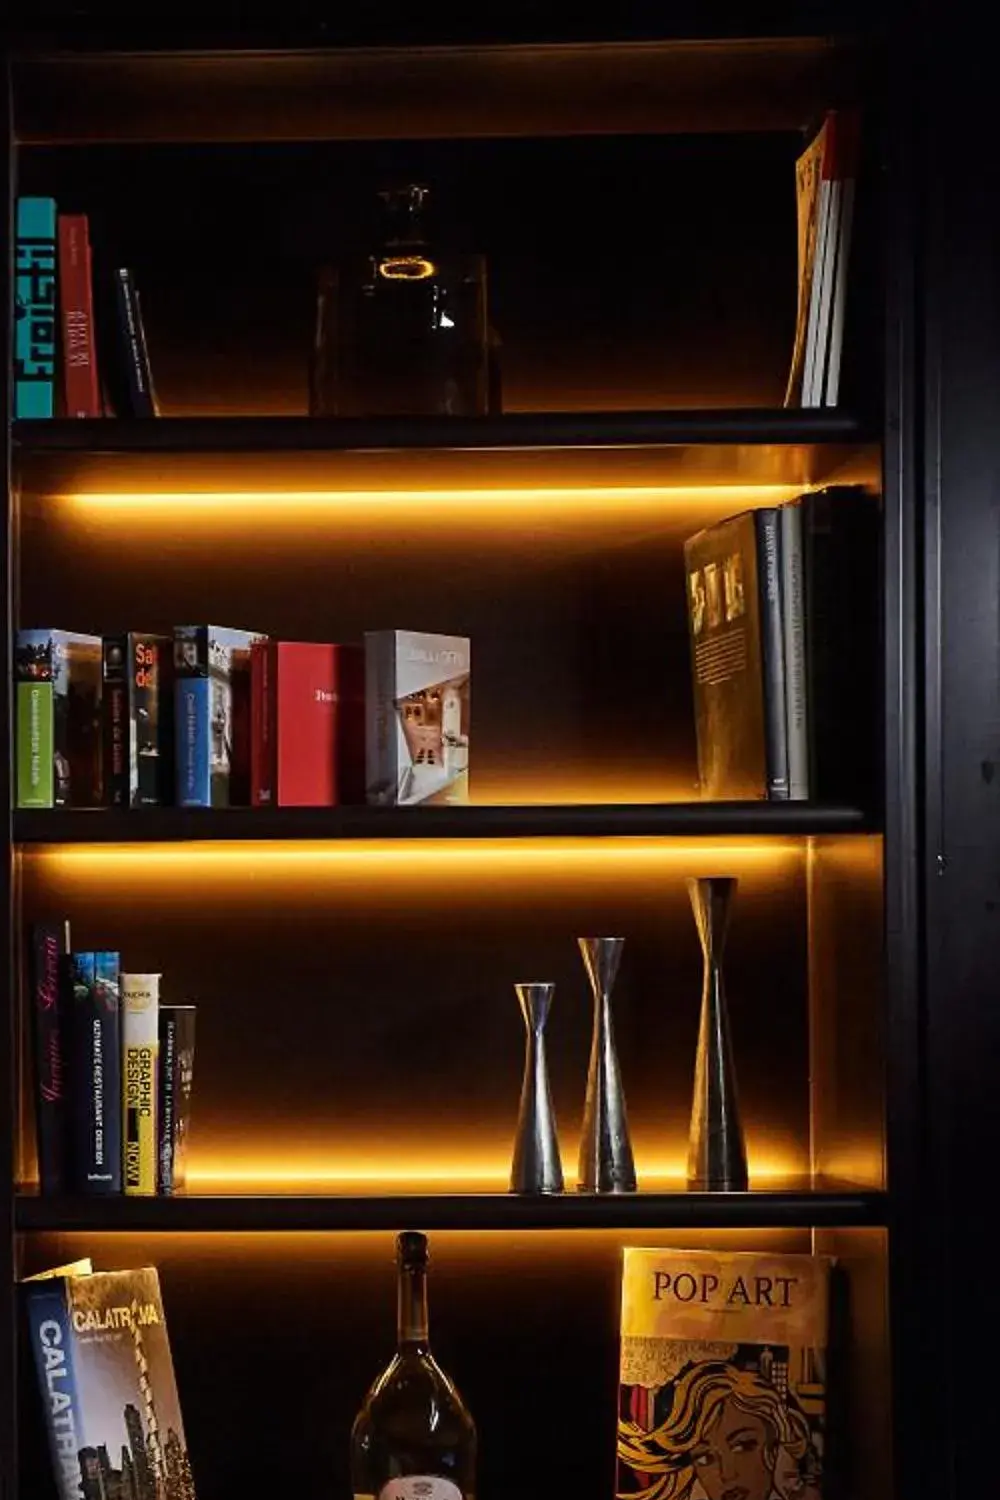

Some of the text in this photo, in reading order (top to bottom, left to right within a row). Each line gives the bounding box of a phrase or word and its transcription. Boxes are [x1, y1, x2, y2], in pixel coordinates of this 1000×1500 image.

[127, 1049, 139, 1105] DESIGN
[139, 1049, 151, 1117] GRAPHIC
[654, 1272, 798, 1307] POP ART
